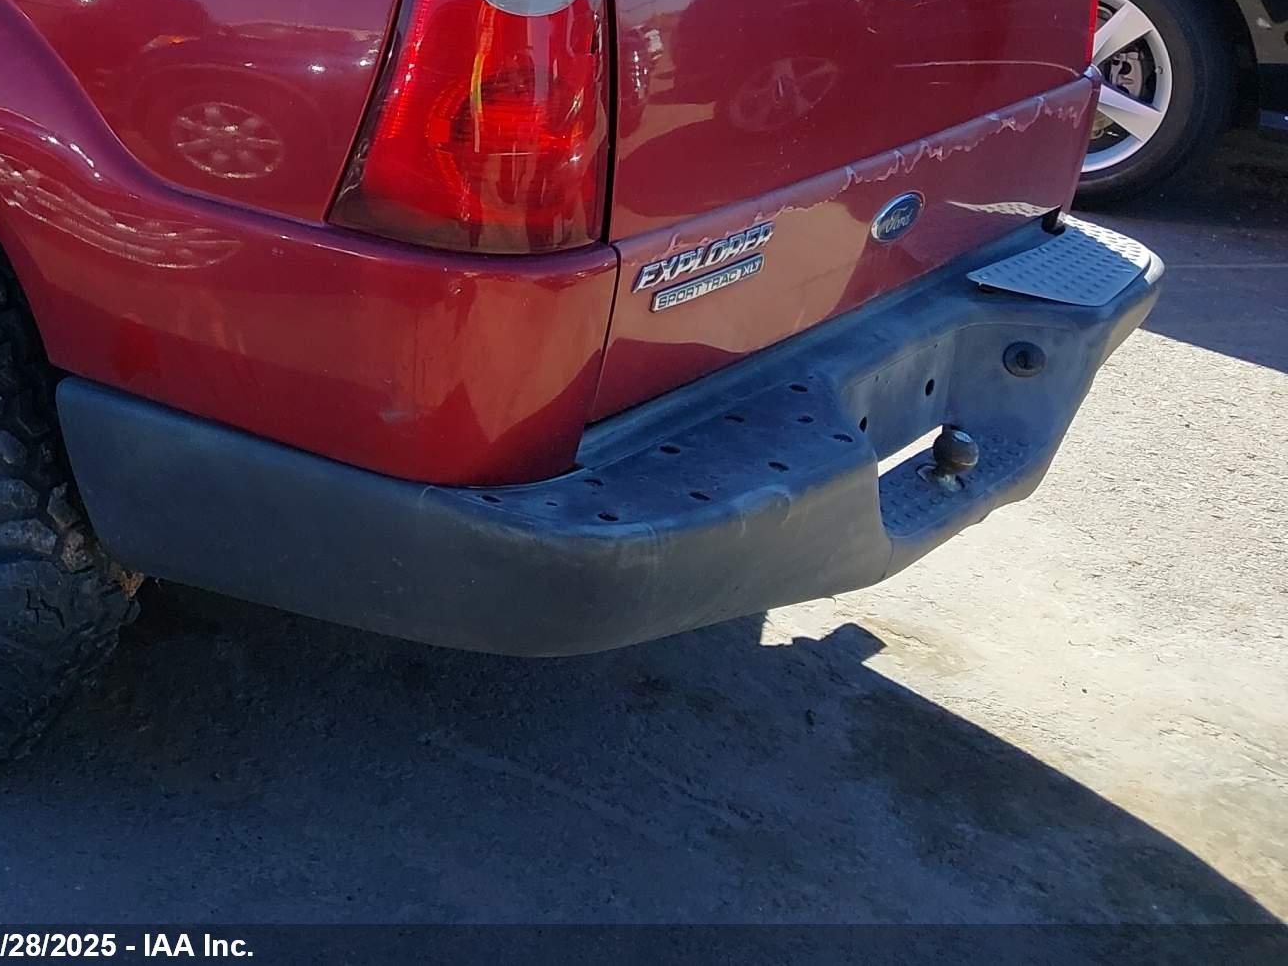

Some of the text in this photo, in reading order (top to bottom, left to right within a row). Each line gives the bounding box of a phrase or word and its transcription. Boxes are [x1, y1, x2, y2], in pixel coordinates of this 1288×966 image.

[631, 221, 774, 293] EXPLORER
[657, 259, 762, 309] SPORT TRAC XLT
